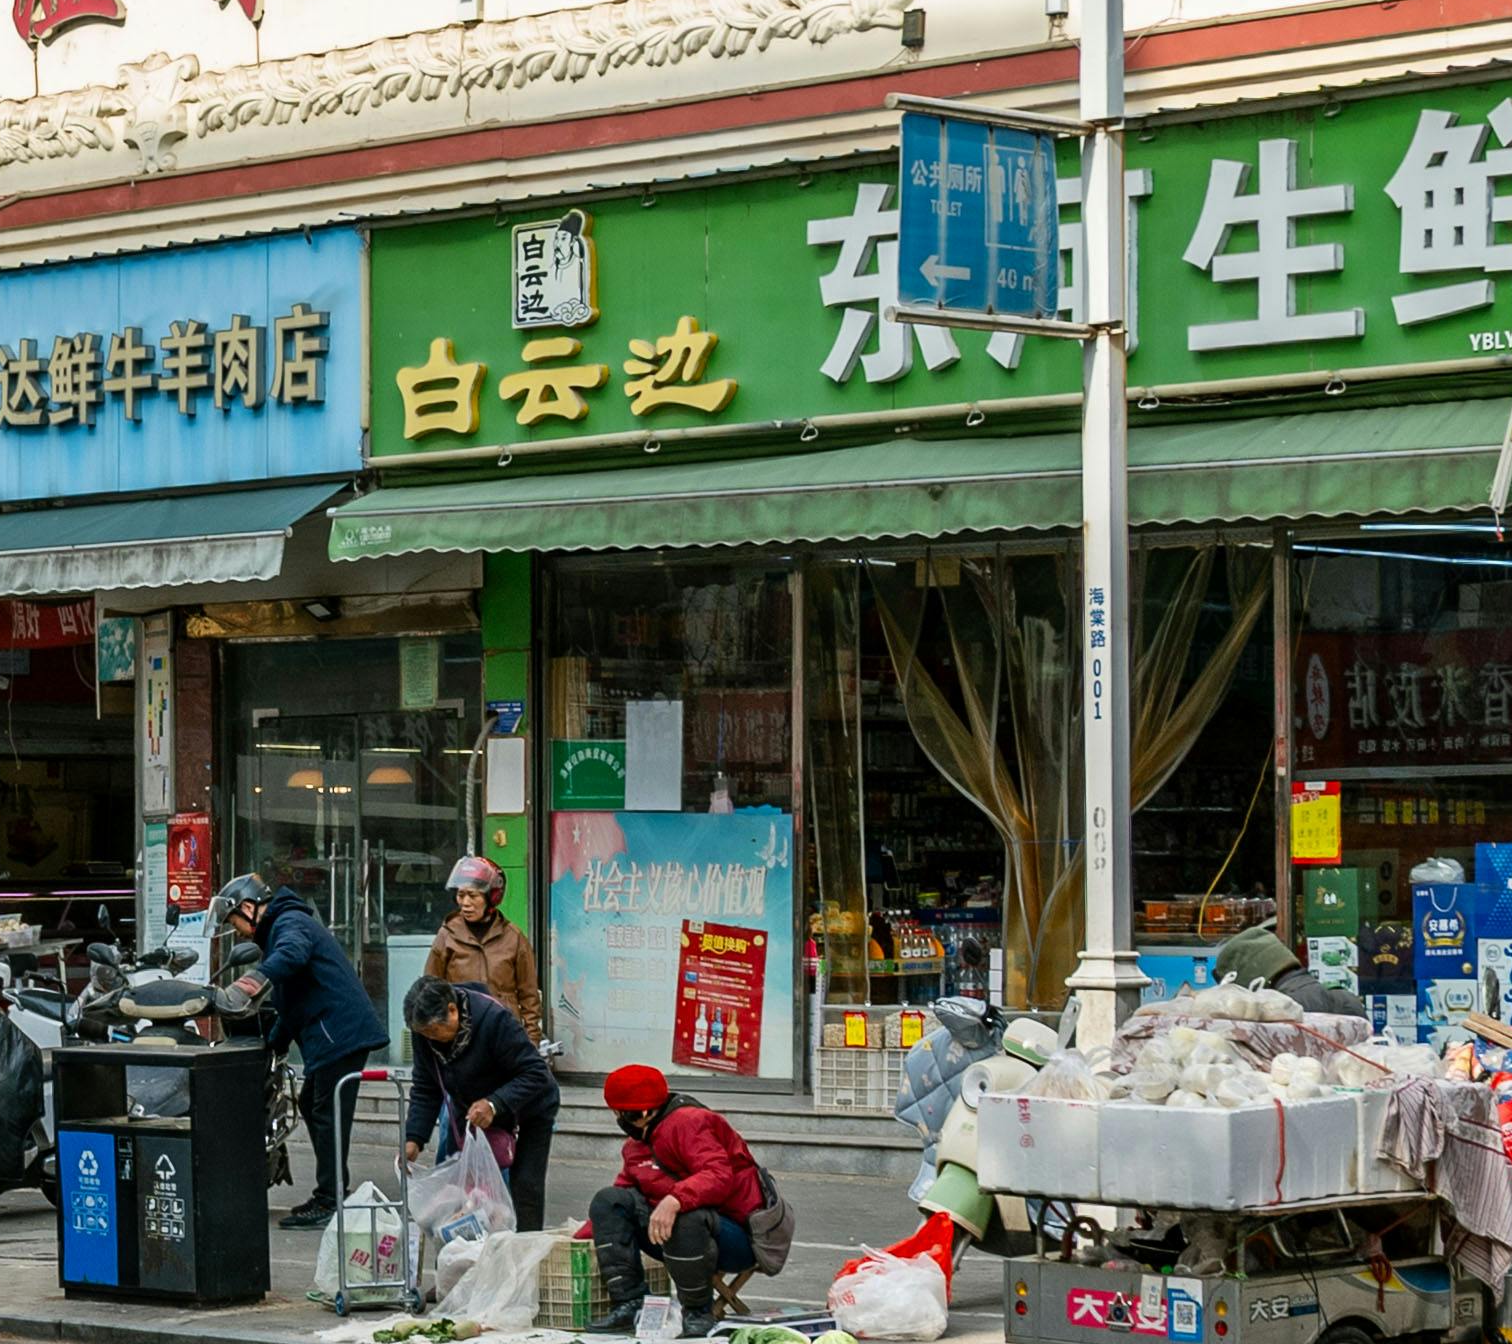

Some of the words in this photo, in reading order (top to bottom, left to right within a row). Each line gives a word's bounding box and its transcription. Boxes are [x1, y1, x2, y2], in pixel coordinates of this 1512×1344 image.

[911, 159, 982, 193] 公共厕所
[520, 233, 550, 316] 白云边
[396, 315, 739, 441] 白云边
[583, 859, 768, 918] 社会主义核心价值观
